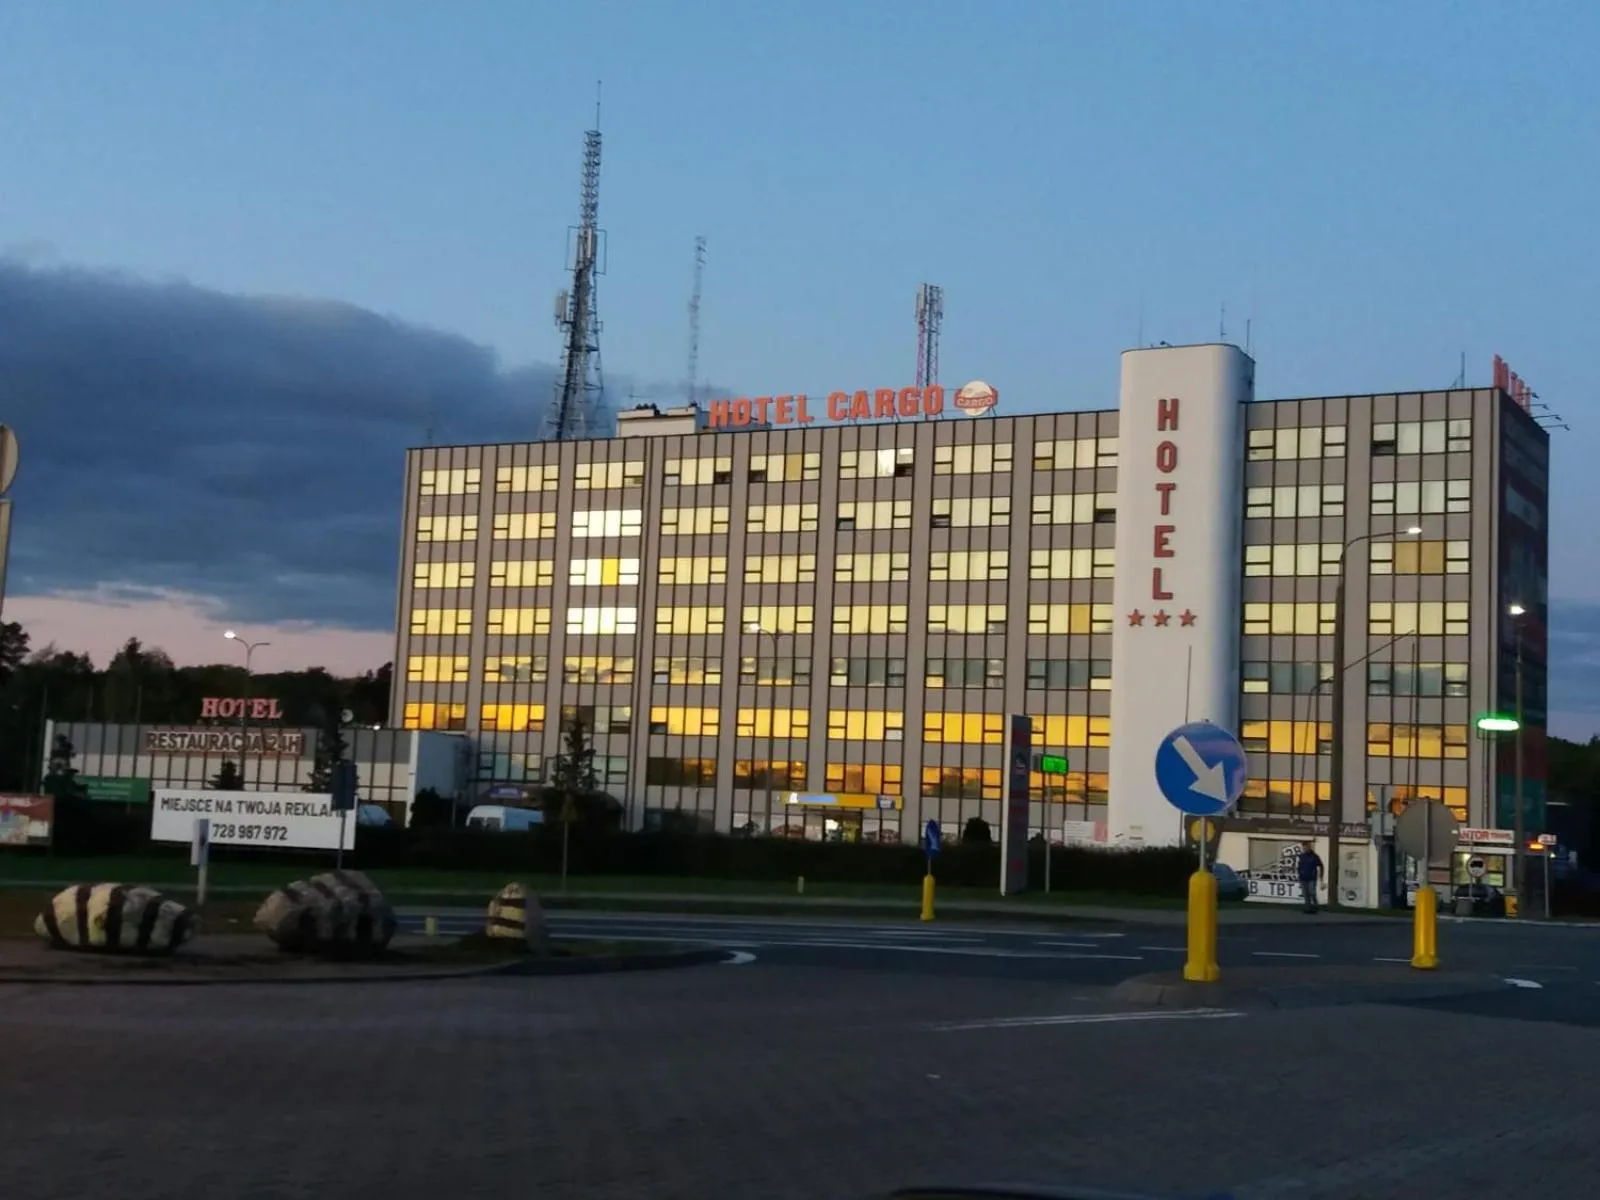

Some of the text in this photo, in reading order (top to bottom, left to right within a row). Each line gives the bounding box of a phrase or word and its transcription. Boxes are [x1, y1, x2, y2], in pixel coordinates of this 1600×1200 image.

[708, 384, 944, 428] HOTEL CARGO
[1152, 398, 1179, 600] HOTEL
[201, 698, 283, 719] HOTEL
[160, 797, 213, 813] MIEJSCE
[215, 800, 233, 814] NA
[237, 800, 281, 816] TWOJA
[212, 824, 289, 841] 728 987 972
